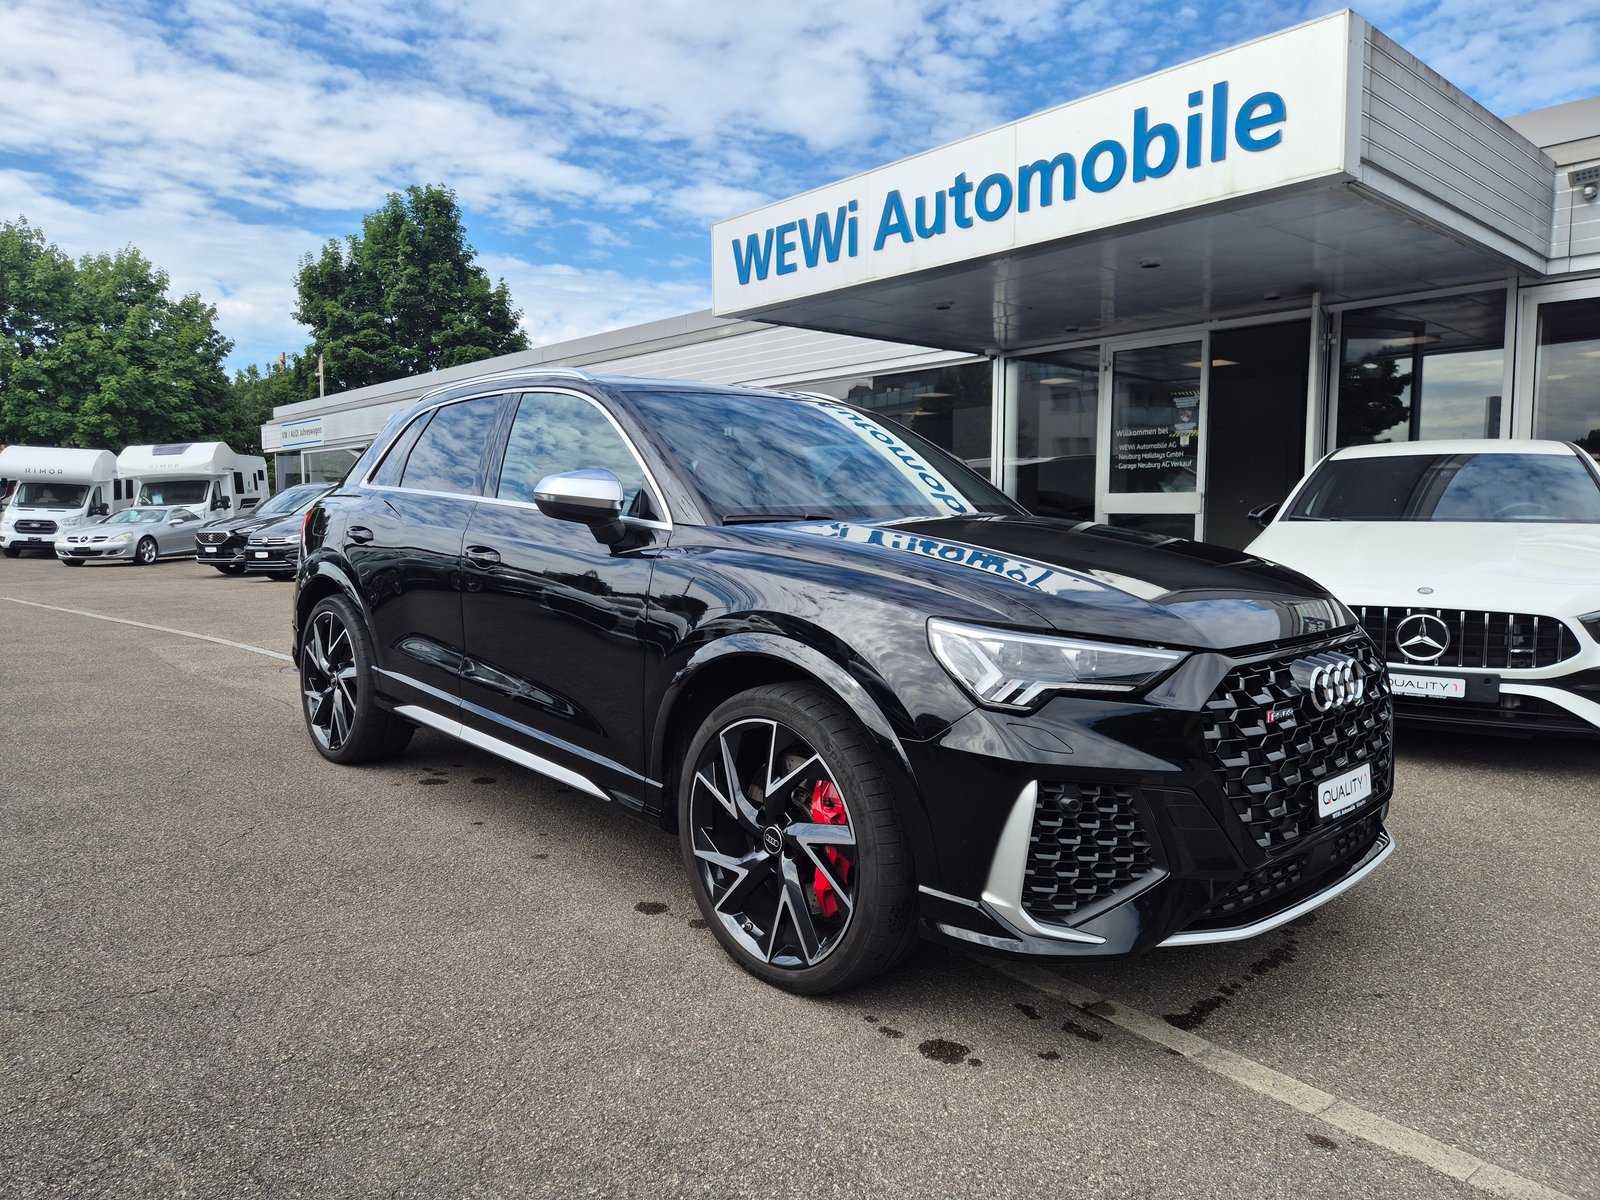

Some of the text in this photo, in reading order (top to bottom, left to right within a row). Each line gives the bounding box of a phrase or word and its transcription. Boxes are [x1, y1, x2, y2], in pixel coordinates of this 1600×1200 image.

[731, 80, 1287, 286] WEWi Automobile
[1116, 429, 1157, 437] Willkommen
[1158, 427, 1169, 435] bei
[1136, 442, 1168, 450] Automobile
[1118, 453, 1141, 461] Neuburg
[1142, 452, 1166, 460] Holidays
[1138, 461, 1161, 469] Neuburg
[1170, 460, 1192, 468] Verkauf
[25, 467, 64, 475] RIMOR
[1322, 774, 1363, 805] QUALITY
